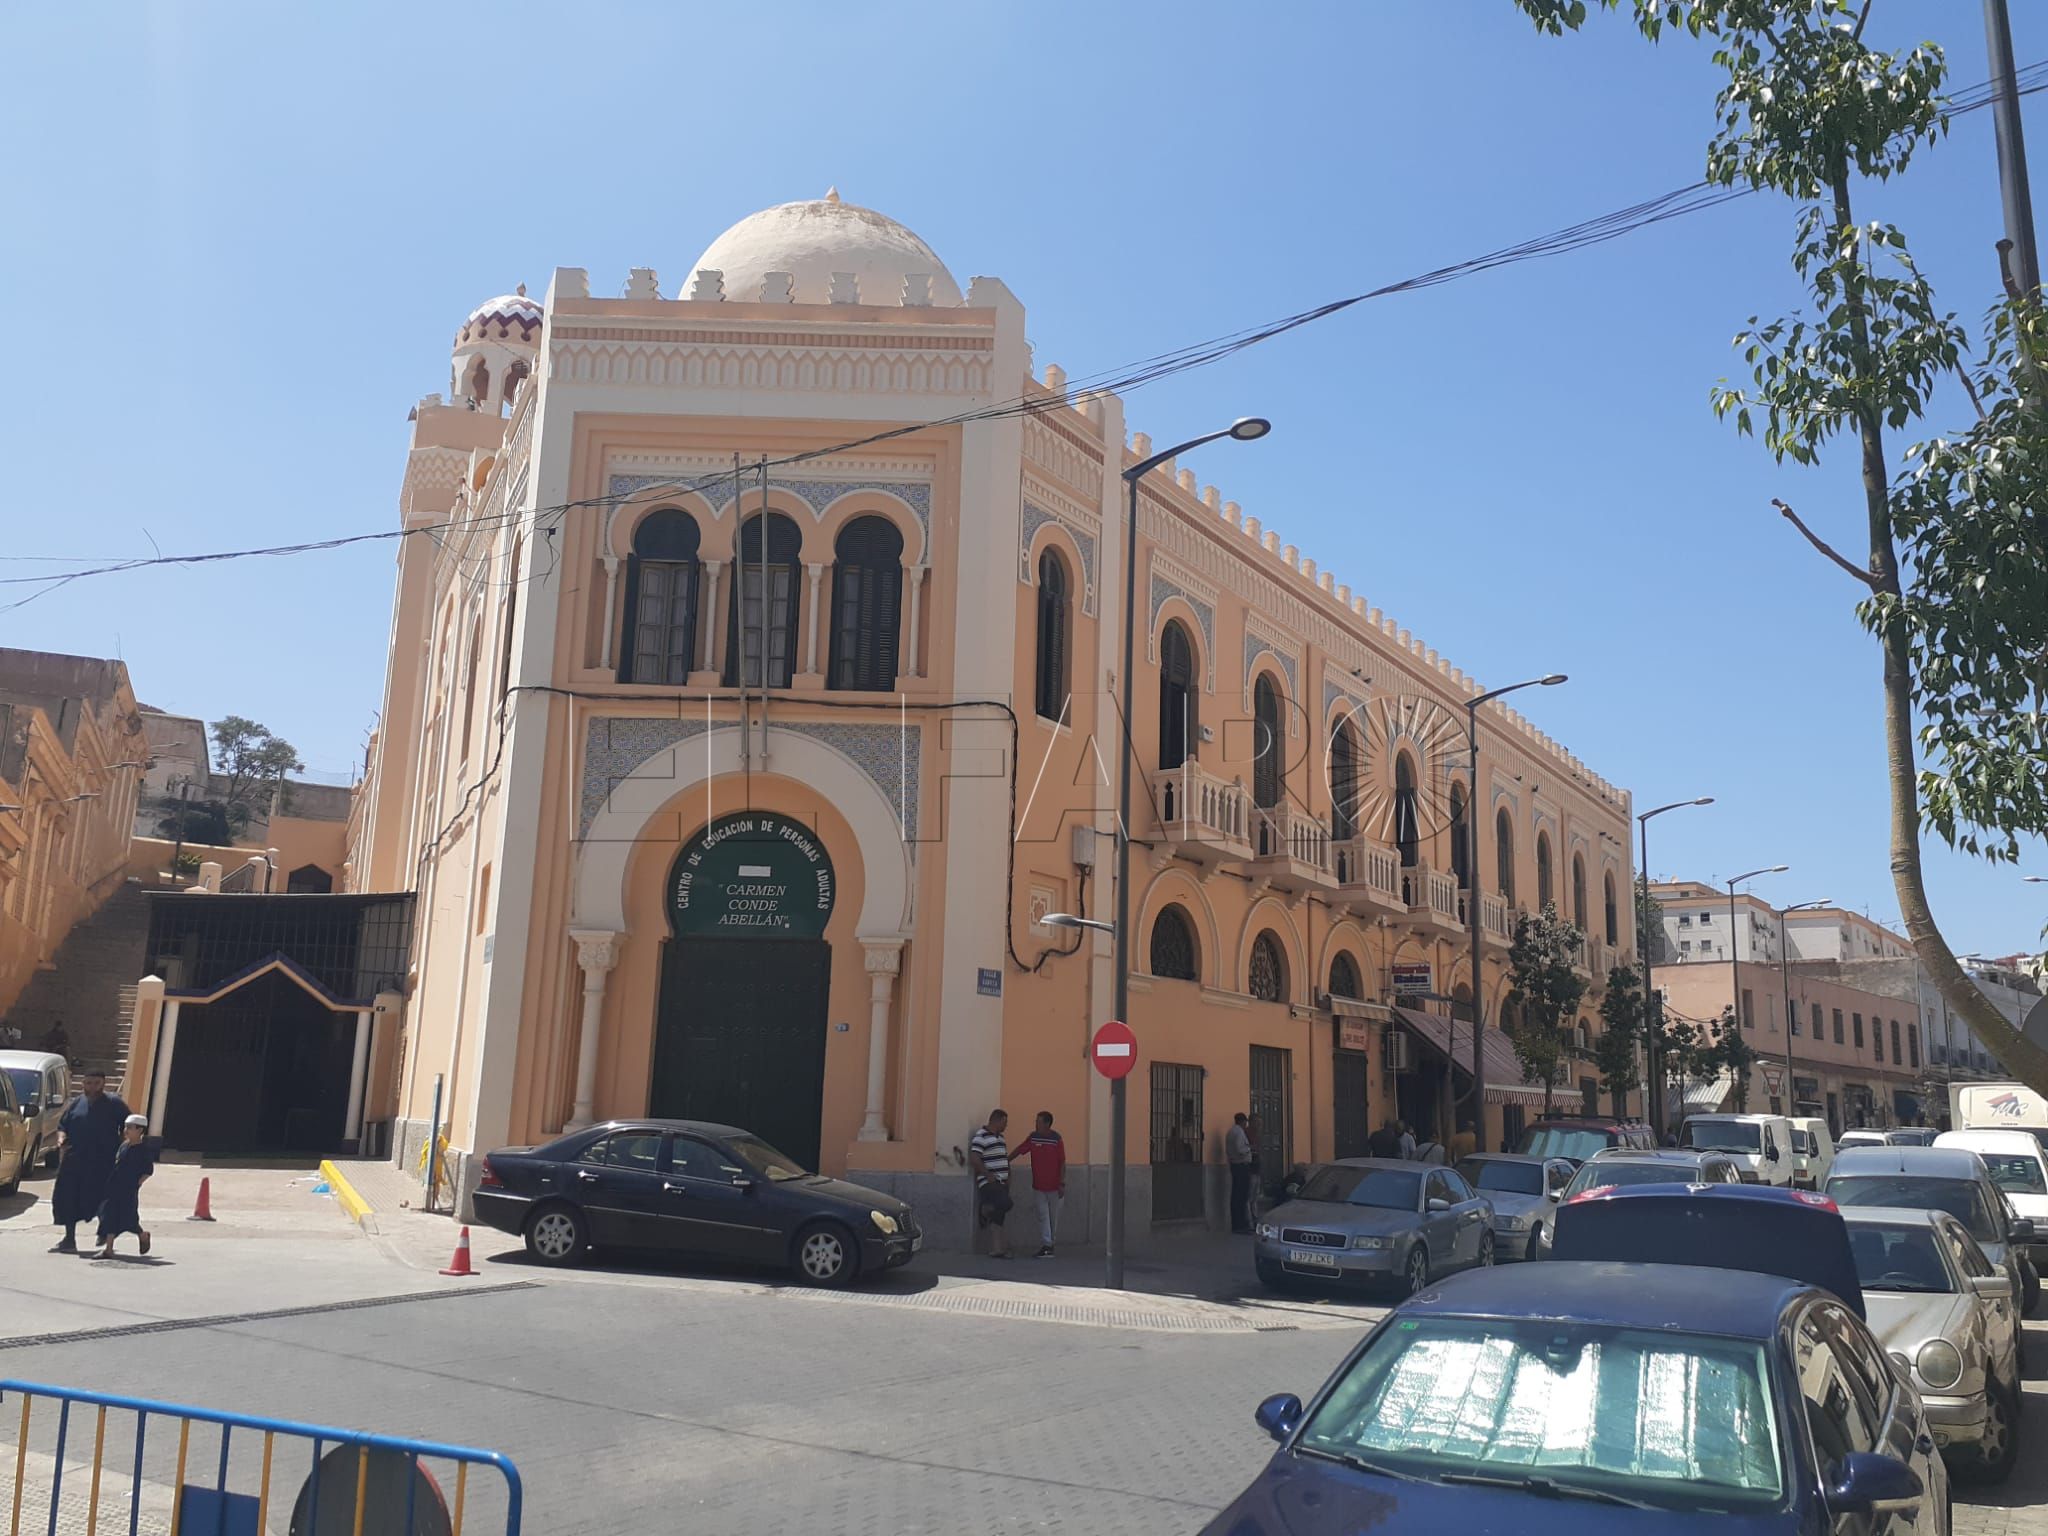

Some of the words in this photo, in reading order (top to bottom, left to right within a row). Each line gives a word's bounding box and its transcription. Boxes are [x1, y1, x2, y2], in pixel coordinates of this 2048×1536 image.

[677, 872, 693, 909] CENTRO
[687, 852, 702, 866] DE
[761, 820, 774, 832] DE
[779, 825, 820, 862] PERSONAS
[816, 869, 831, 910] ADULTAS
[728, 899, 778, 911] CONDE
